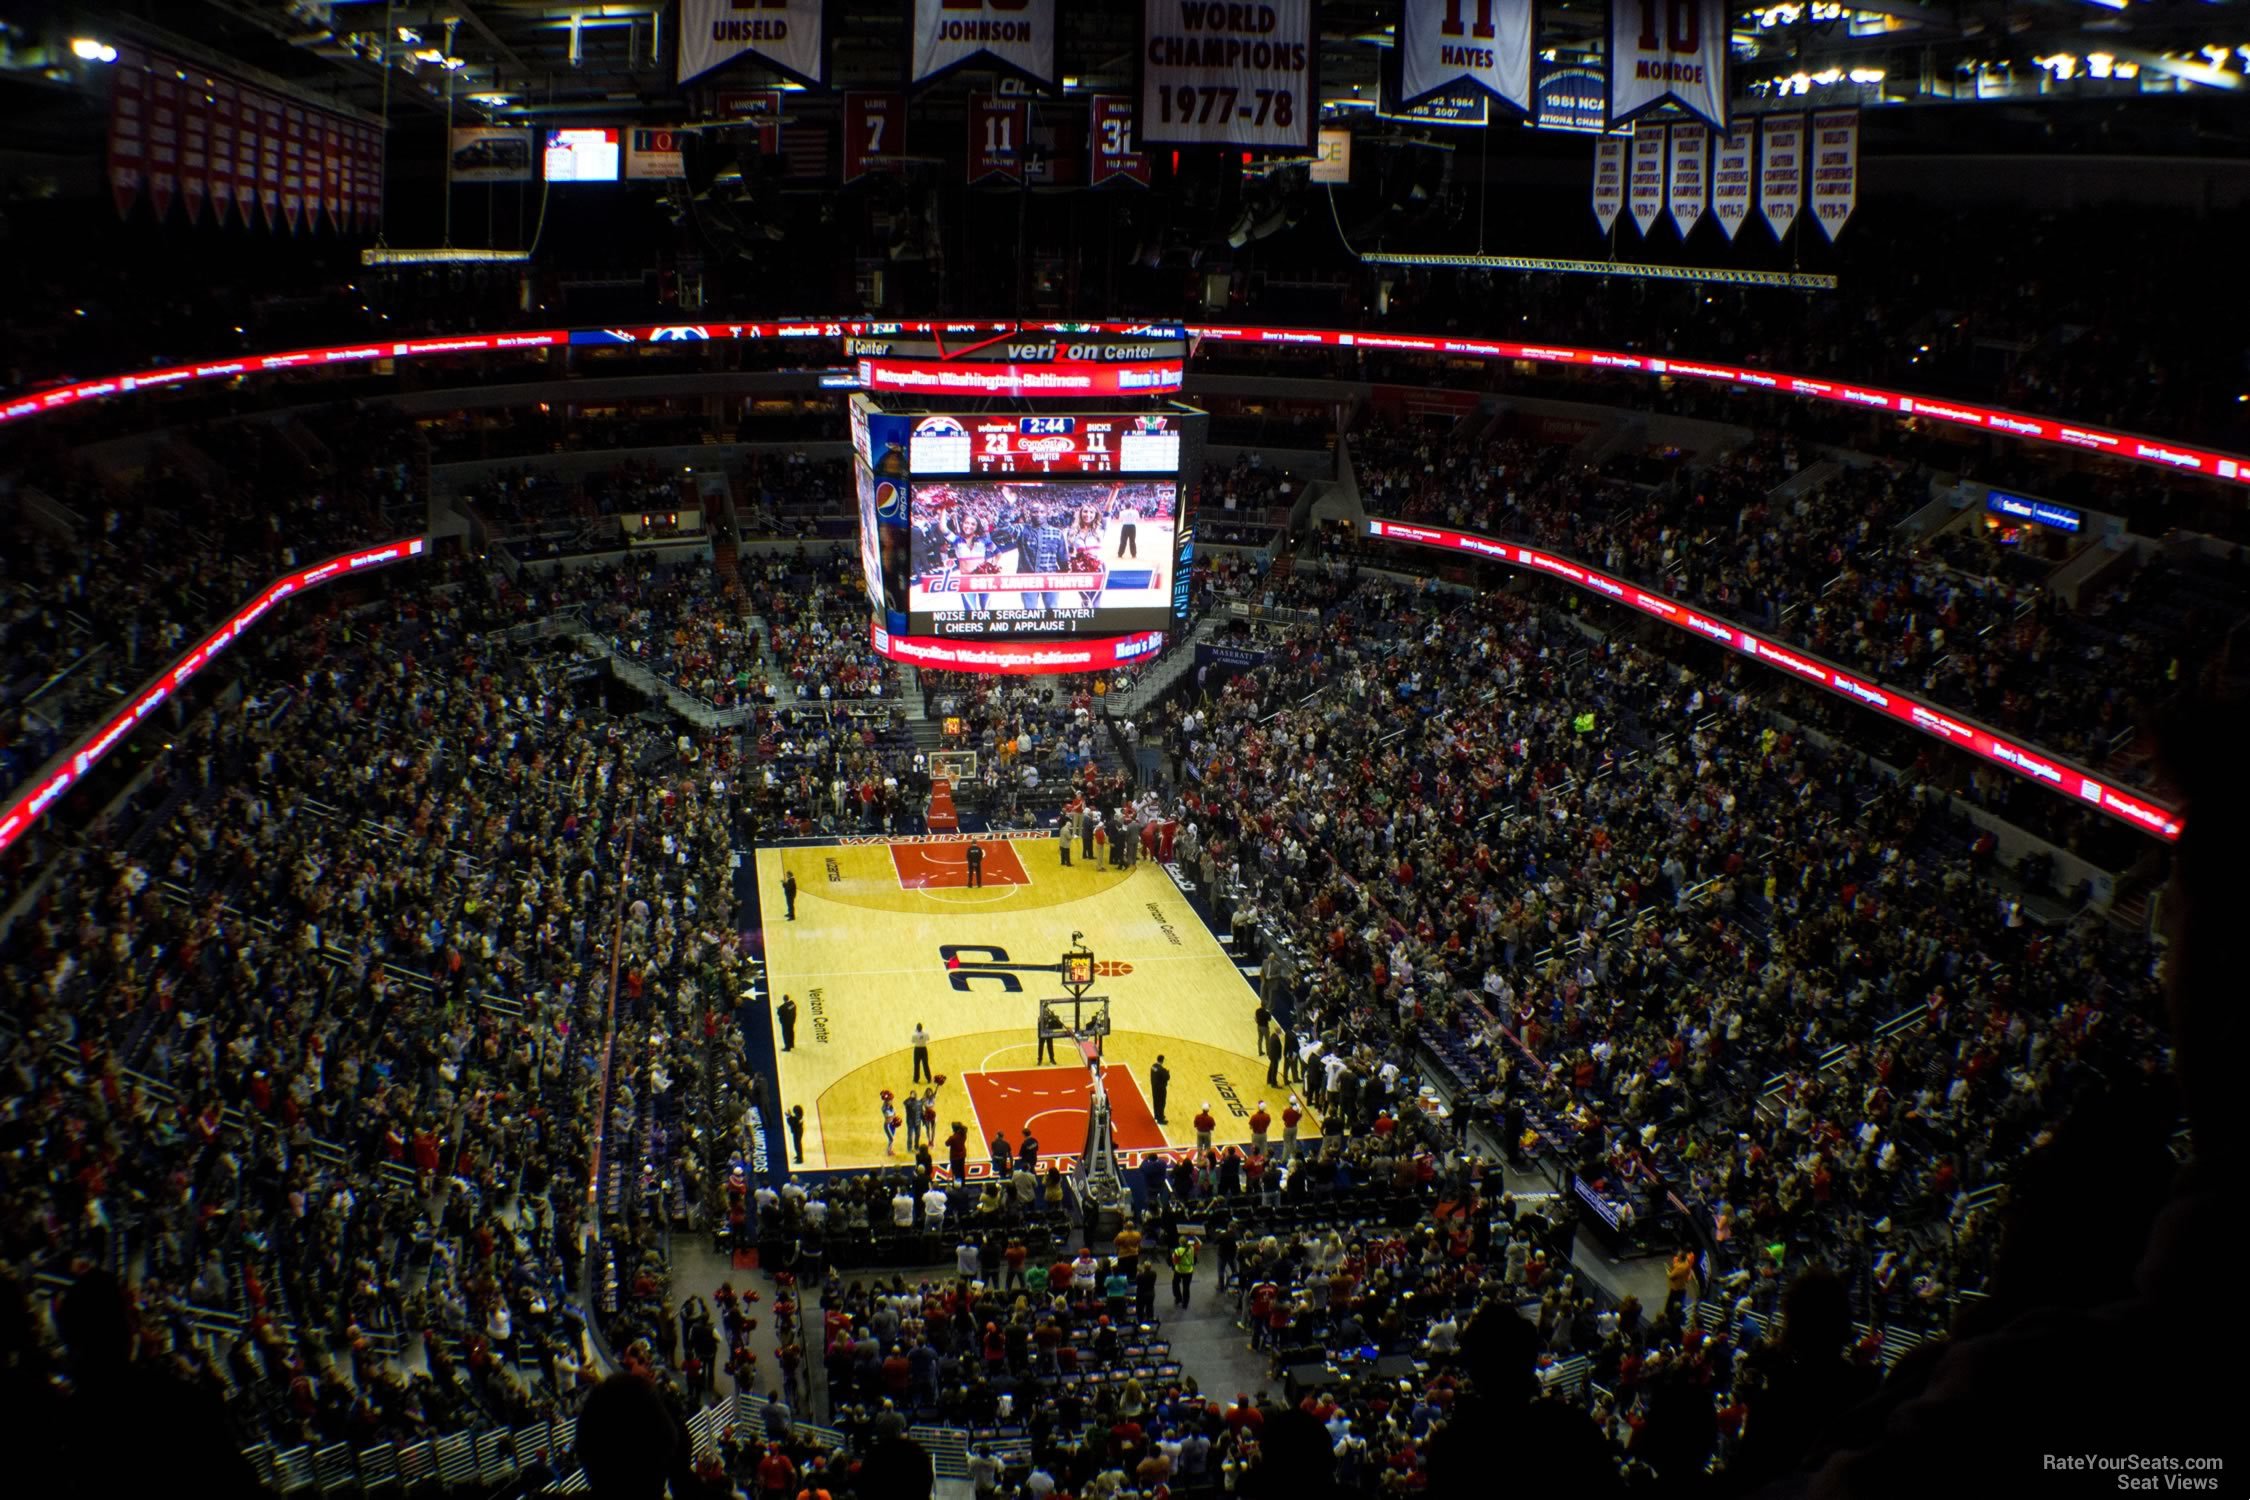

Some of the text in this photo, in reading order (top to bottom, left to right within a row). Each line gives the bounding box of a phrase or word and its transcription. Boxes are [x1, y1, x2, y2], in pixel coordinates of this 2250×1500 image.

[1181, 1, 1275, 33] WORLD
[1442, 0, 1494, 38] 11
[1639, 0, 1699, 53] 10
[713, 20, 787, 41] UNSELD
[939, 20, 1030, 42] JOHNSON
[1148, 36, 1305, 71] CHAMPIONS
[1441, 45, 1494, 68] HAYES
[1636, 60, 1703, 84] MONROE
[1159, 84, 1292, 127] 1977-78
[1435, 106, 1459, 118] 2007
[866, 114, 886, 152] 7
[985, 116, 1011, 151] 11
[825, 324, 841, 336] 23
[1163, 328, 1176, 337] PM
[855, 339, 889, 355] Center
[1007, 340, 1155, 361] verizon Center
[876, 368, 1091, 391] Metropolitan Washington-Baltimore
[1118, 368, 1161, 388] Hero's
[1029, 418, 1065, 433] 2:44
[1086, 423, 1112, 432] BUCKS
[985, 433, 1008, 453] 23
[1087, 433, 1107, 452] 11
[1032, 453, 1060, 462] QUARTER
[1043, 461, 1050, 472] 1
[1079, 454, 1095, 462] FOULS
[899, 486, 907, 521] pepsi
[970, 576, 1093, 589] SGT. XAVIER THAYER
[933, 609, 1095, 621] NOISE FOR SERGEANT THAYER!
[945, 623, 984, 633] CHEERS
[989, 622, 1009, 632] AND
[1014, 621, 1065, 631] APPLAUSE
[894, 639, 1091, 667] Metropolitan Washington-Baltimore
[1116, 639, 1148, 659] Hero's
[1212, 648, 1253, 660] MASERATI
[1222, 658, 1250, 666] ARLINGTON
[839, 829, 1052, 846] WASHINGTON
[825, 857, 841, 883] wizards
[1145, 901, 1182, 947] Verizon Center
[809, 988, 829, 1044] Verizon Center
[1209, 1073, 1250, 1119] wizards
